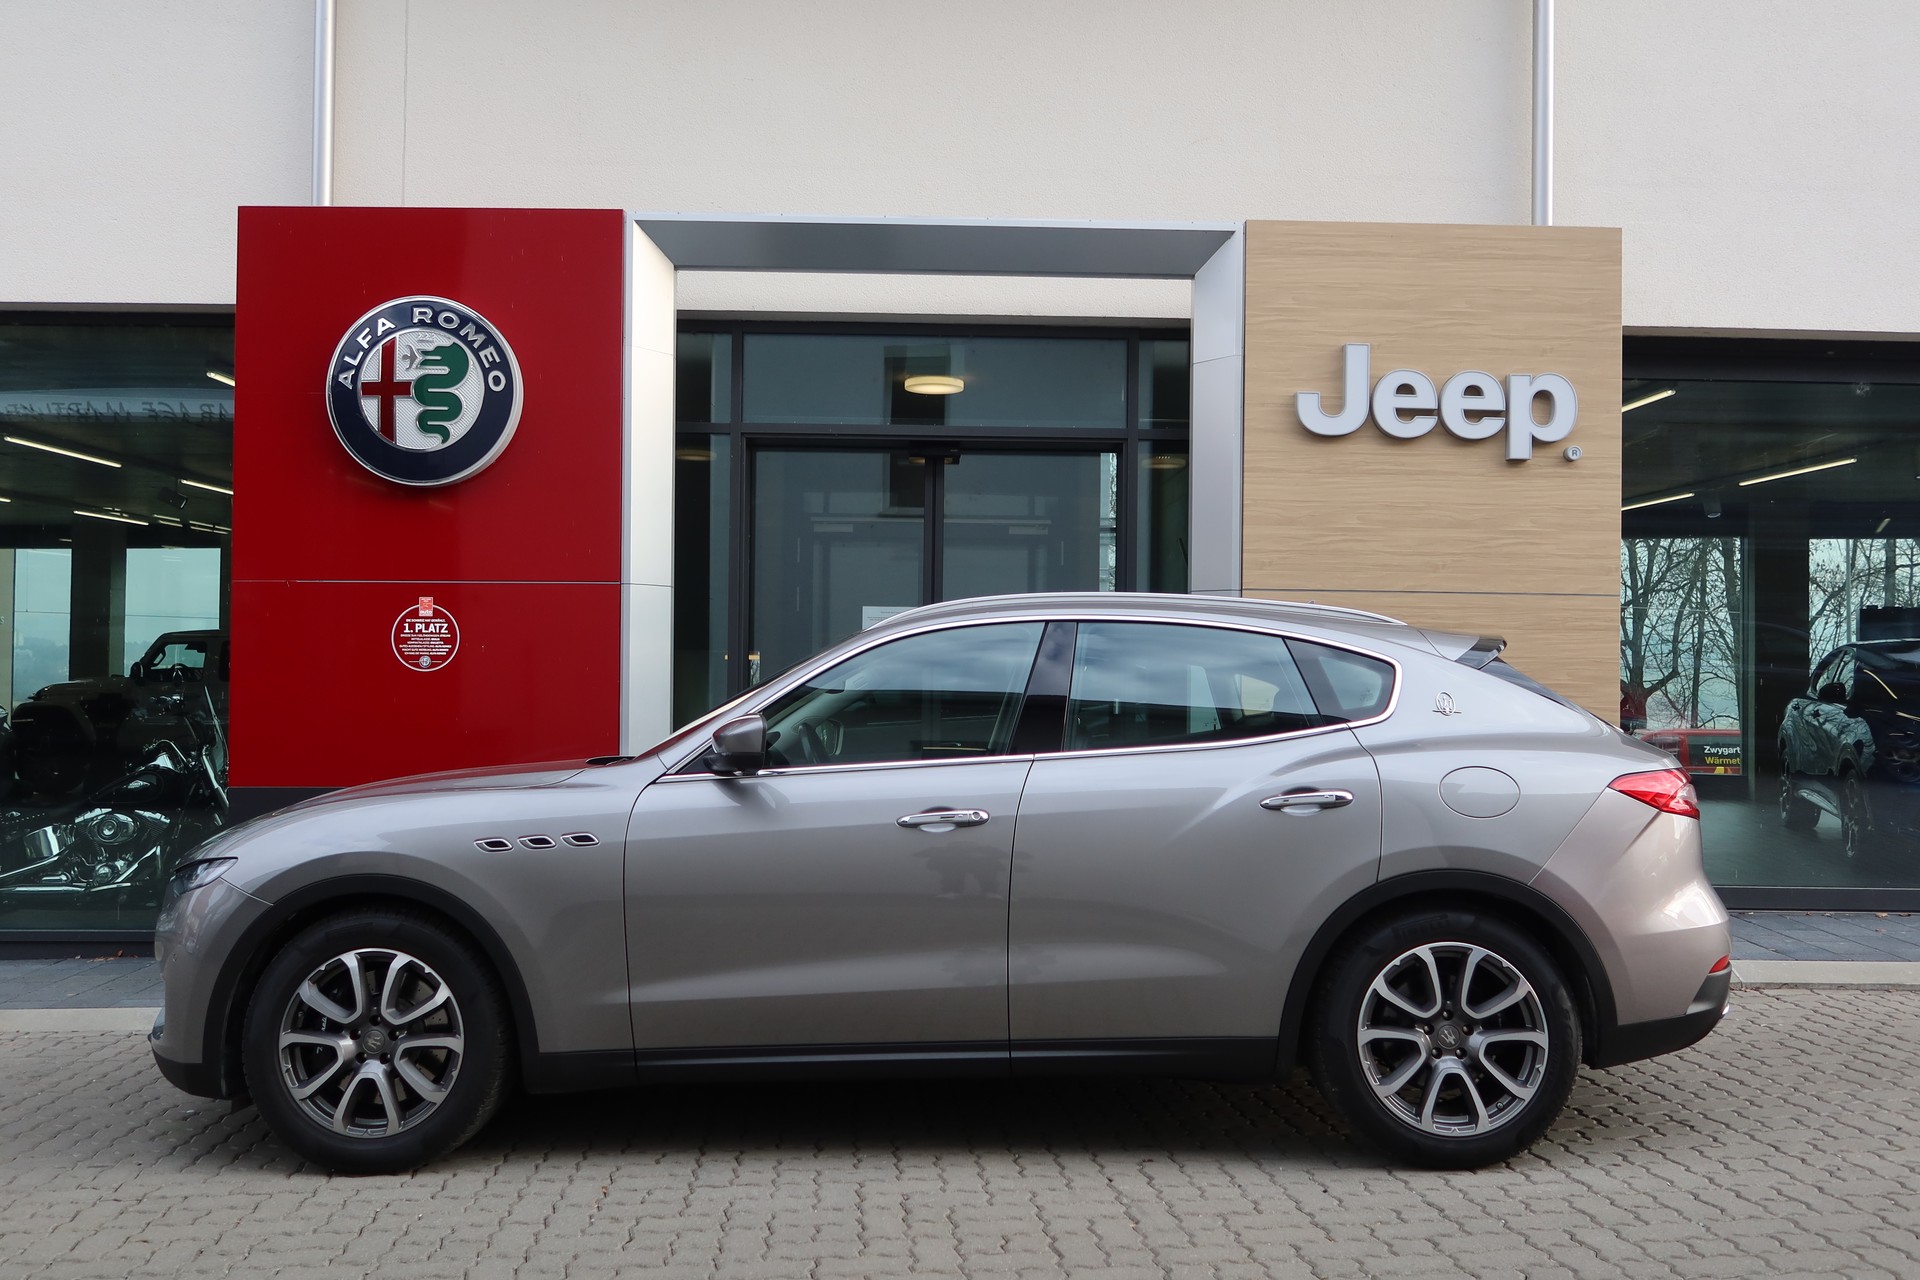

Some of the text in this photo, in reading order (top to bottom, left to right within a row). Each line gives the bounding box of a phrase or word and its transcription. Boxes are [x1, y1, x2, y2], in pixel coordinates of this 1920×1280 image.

[338, 307, 507, 392] ALFA ROMEO
[1295, 343, 1578, 461] Jeep
[403, 623, 448, 633] 1. PLATZ
[1703, 745, 1741, 755] Zwygart
